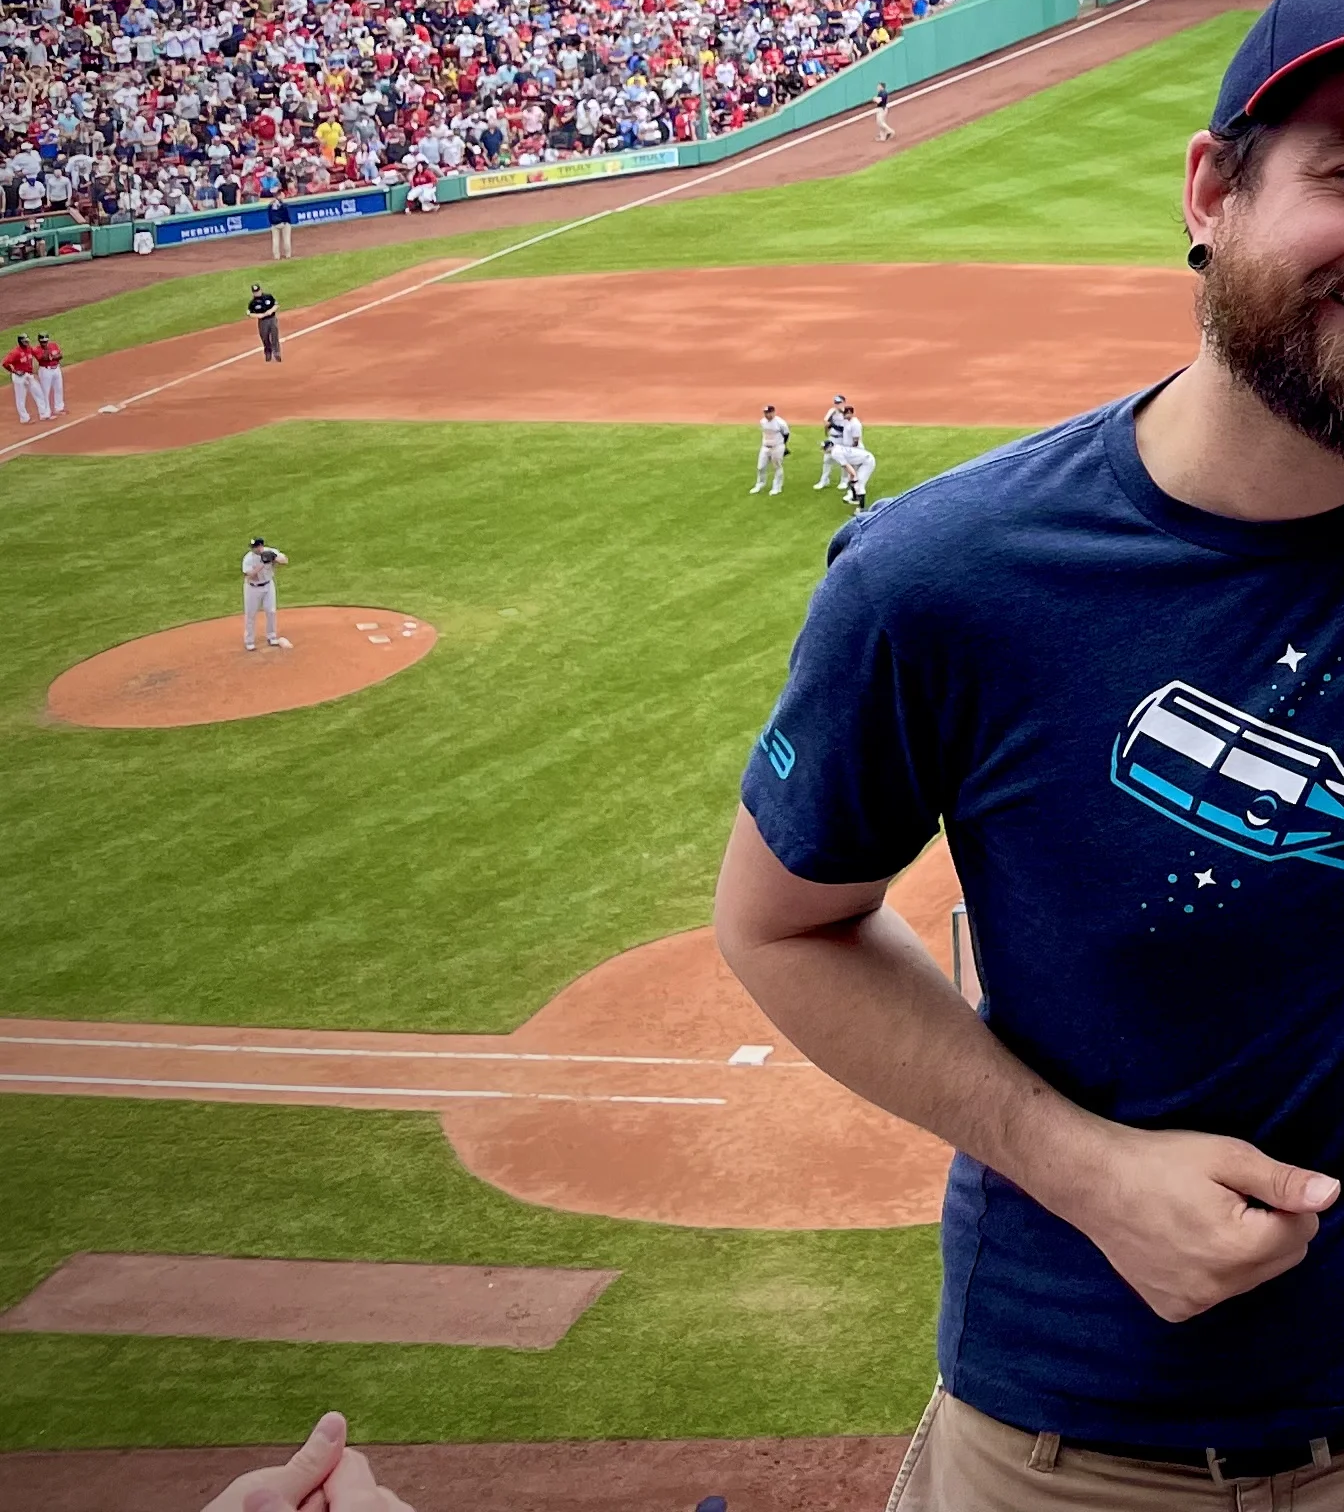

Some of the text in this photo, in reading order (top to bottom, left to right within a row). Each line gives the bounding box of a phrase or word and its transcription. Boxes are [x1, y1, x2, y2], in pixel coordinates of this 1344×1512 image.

[633, 152, 667, 165] TRULY
[557, 163, 591, 176] TRULY
[479, 173, 515, 186] TRULY
[297, 206, 341, 221] MERRILL
[181, 223, 226, 239] MERRILL
